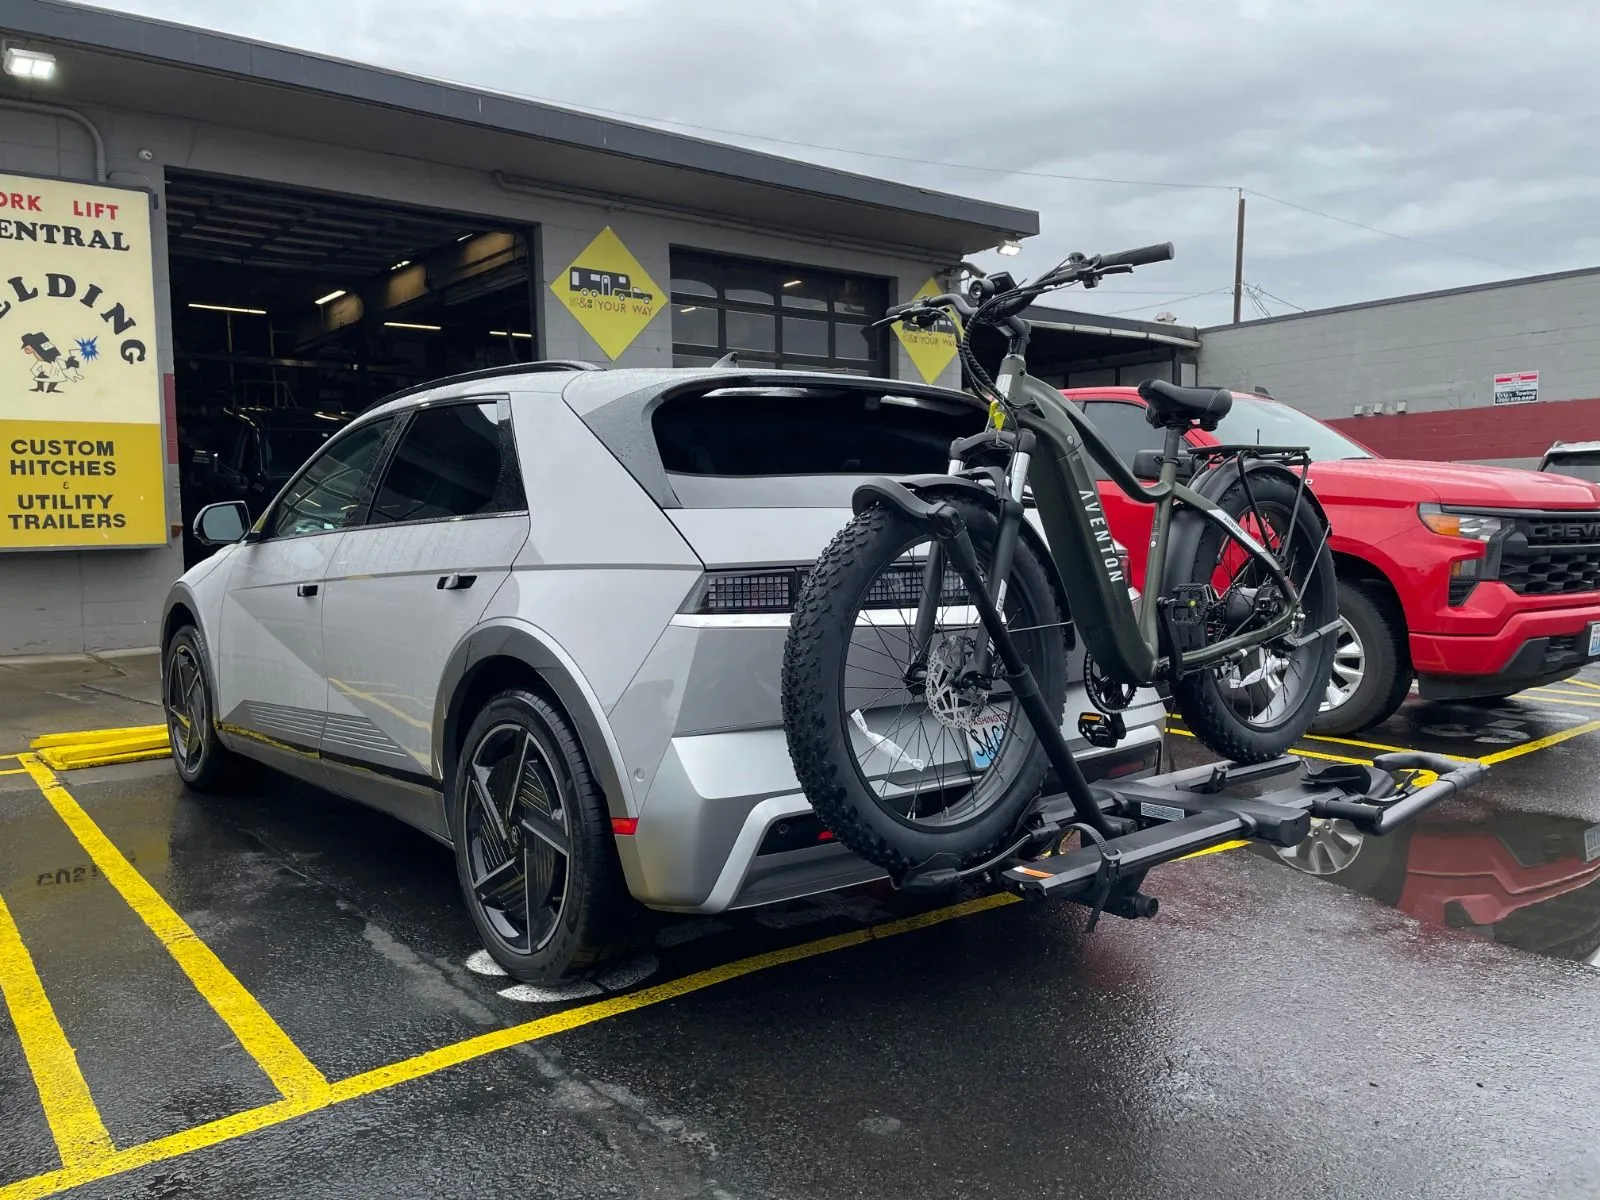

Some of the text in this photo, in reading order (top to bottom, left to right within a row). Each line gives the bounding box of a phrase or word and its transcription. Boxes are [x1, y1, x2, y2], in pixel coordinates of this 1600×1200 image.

[73, 200, 119, 221] LIFT
[0, 218, 130, 252] ENTRAL
[598, 300, 626, 313] YOUR
[632, 305, 653, 317] WAY
[10, 439, 114, 457] CUSTOM
[10, 459, 116, 476] HITCHES
[18, 494, 114, 510] UTILITY
[8, 513, 126, 530] TRAILERS
[1078, 489, 1123, 583] AVENTON
